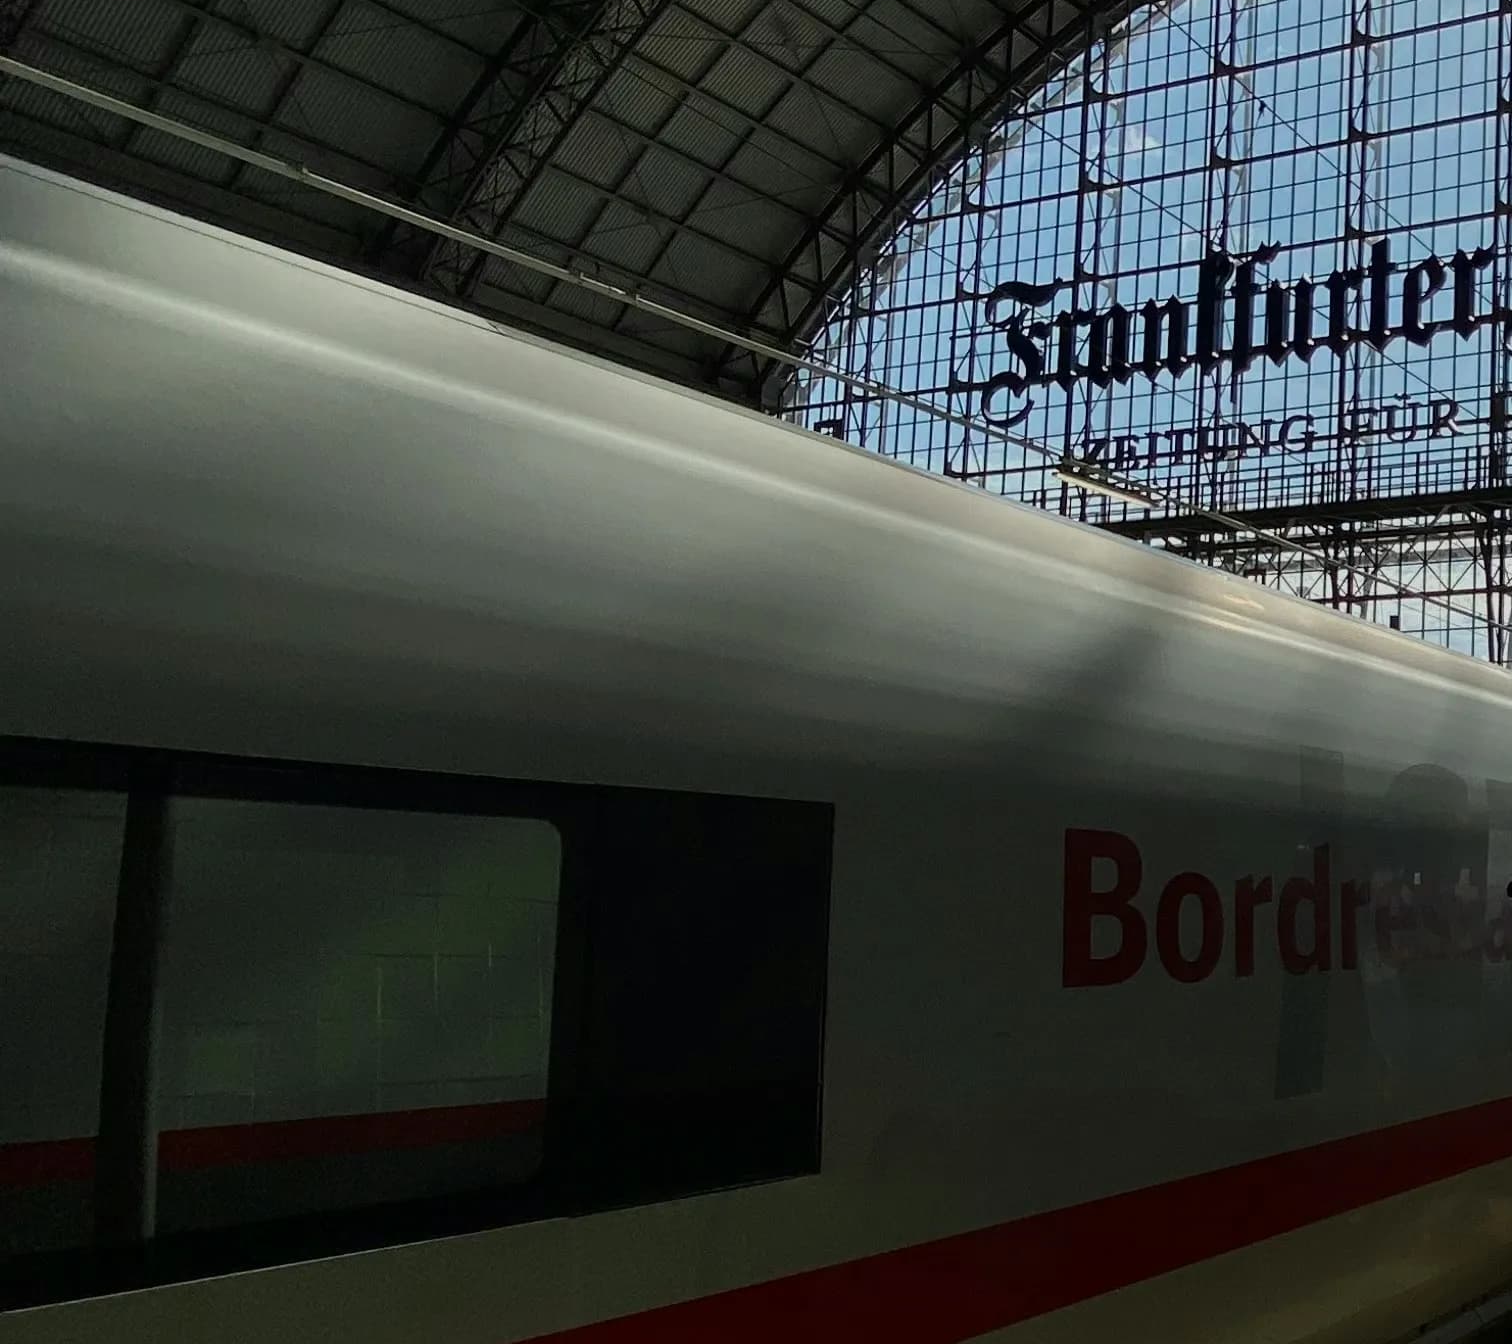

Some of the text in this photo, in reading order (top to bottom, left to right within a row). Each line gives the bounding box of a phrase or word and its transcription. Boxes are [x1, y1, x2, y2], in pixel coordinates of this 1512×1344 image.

[981, 238, 1497, 427] Frankfurter
[1081, 413, 1316, 470] ZEITUNG
[1346, 393, 1464, 447] FÜR
